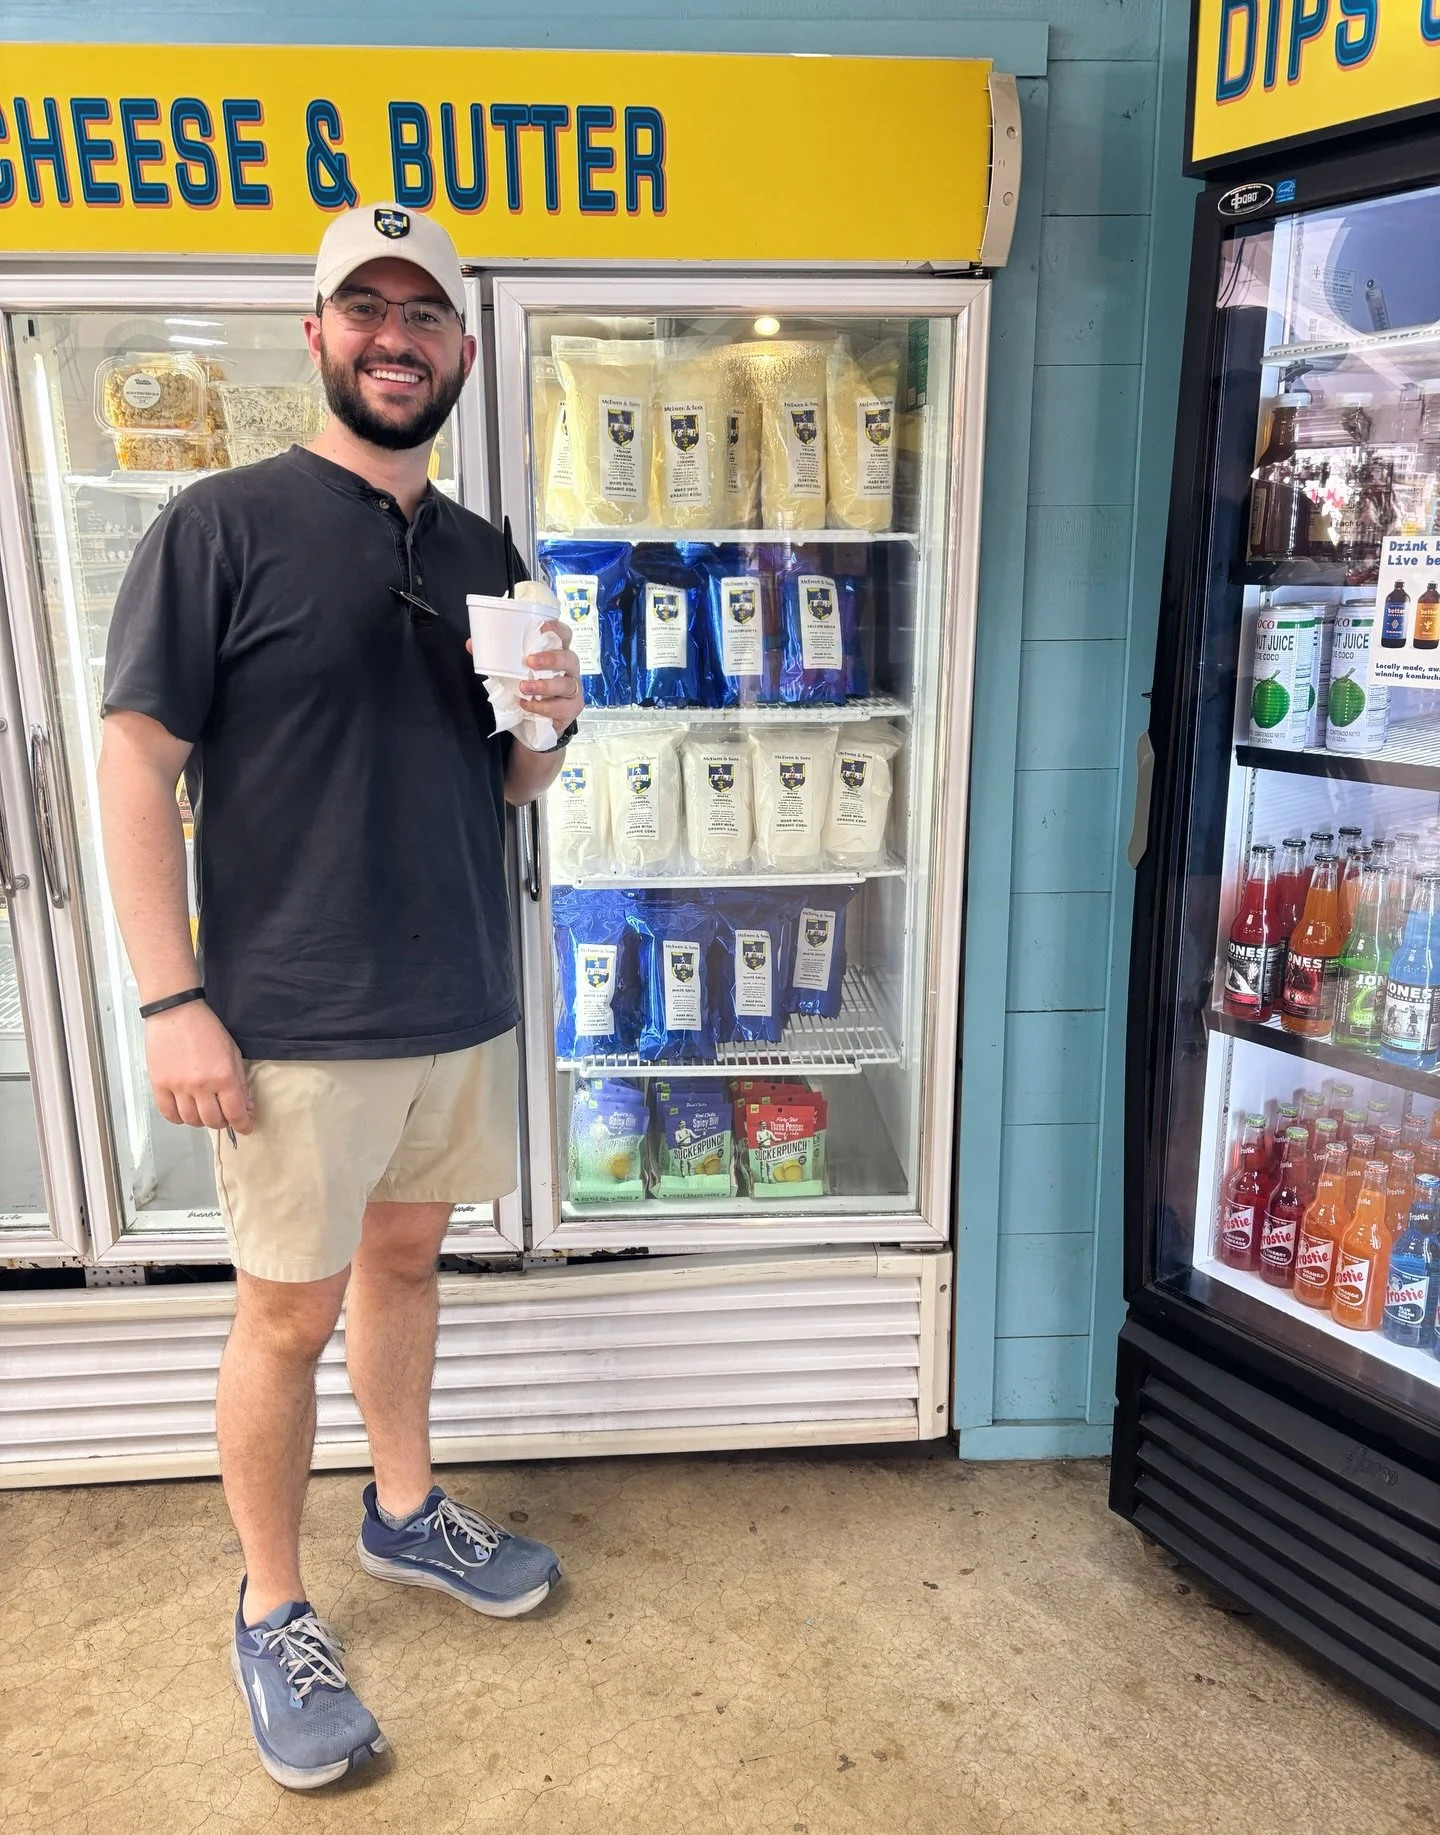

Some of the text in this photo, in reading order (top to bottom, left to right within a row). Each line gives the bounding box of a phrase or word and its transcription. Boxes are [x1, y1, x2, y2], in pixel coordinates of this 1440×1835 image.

[306, 99, 359, 209] &
[388, 101, 666, 213] BUTTER
[1389, 540, 1428, 551] Drink
[1388, 555, 1418, 566] Live
[1257, 619, 1275, 630] OCO
[1268, 635, 1294, 651] JUICE
[1342, 633, 1370, 649] JUICE
[1263, 653, 1280, 661] COCO
[1338, 651, 1355, 659] COCO
[1376, 662, 1401, 671] Locally
[1403, 664, 1425, 672] made,
[1375, 670, 1403, 680] winning
[1229, 943, 1266, 958] ONES
[1288, 952, 1323, 969] ONES
[1356, 974, 1387, 986] JON
[770, 1121, 804, 1132] Three Pepper
[674, 1134, 724, 1160] SUCKERPUNCH
[754, 1140, 808, 1160] SUCKERPUNCH
[1223, 1216, 1250, 1230] rostie
[1261, 1231, 1292, 1246] rostie
[1303, 1269, 1324, 1278] ORANGE
[1336, 1269, 1364, 1284] rostie
